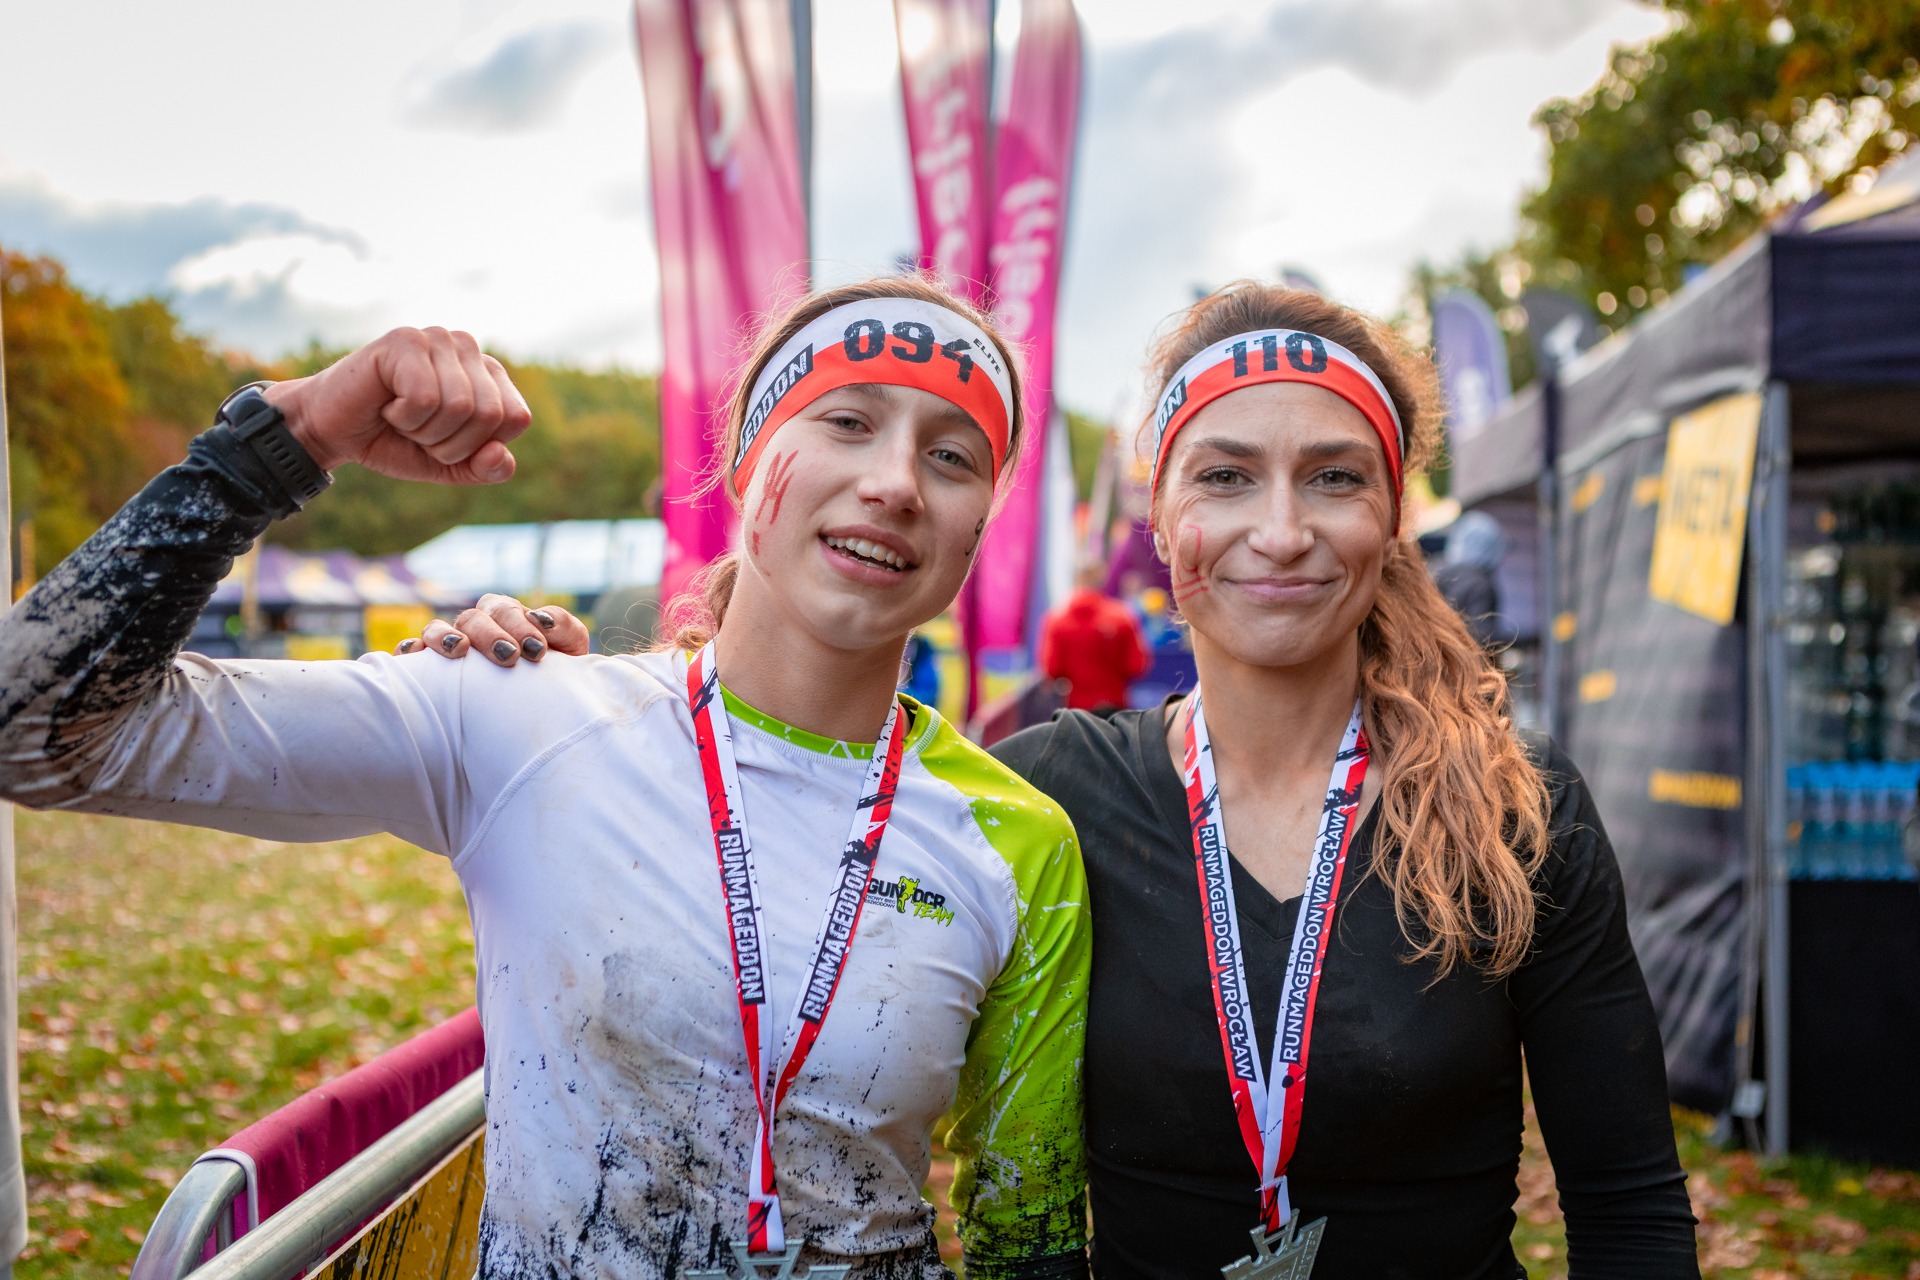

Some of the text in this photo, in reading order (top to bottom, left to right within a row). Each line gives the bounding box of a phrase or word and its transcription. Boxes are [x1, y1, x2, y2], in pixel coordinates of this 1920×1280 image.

[843, 318, 975, 385] 094
[972, 338, 1002, 375] ELITE
[1225, 332, 1328, 378] 110
[718, 832, 764, 1002] RUNMAGEDDON
[912, 888, 946, 909] OCR
[912, 902, 955, 927] TEAM
[802, 860, 871, 1023] RUNMAGEDDON
[1199, 825, 1253, 1080] RUNMAGEDDON WROCŁAW
[1282, 811, 1348, 1062] RUNMAGEDDON WROCŁAW
